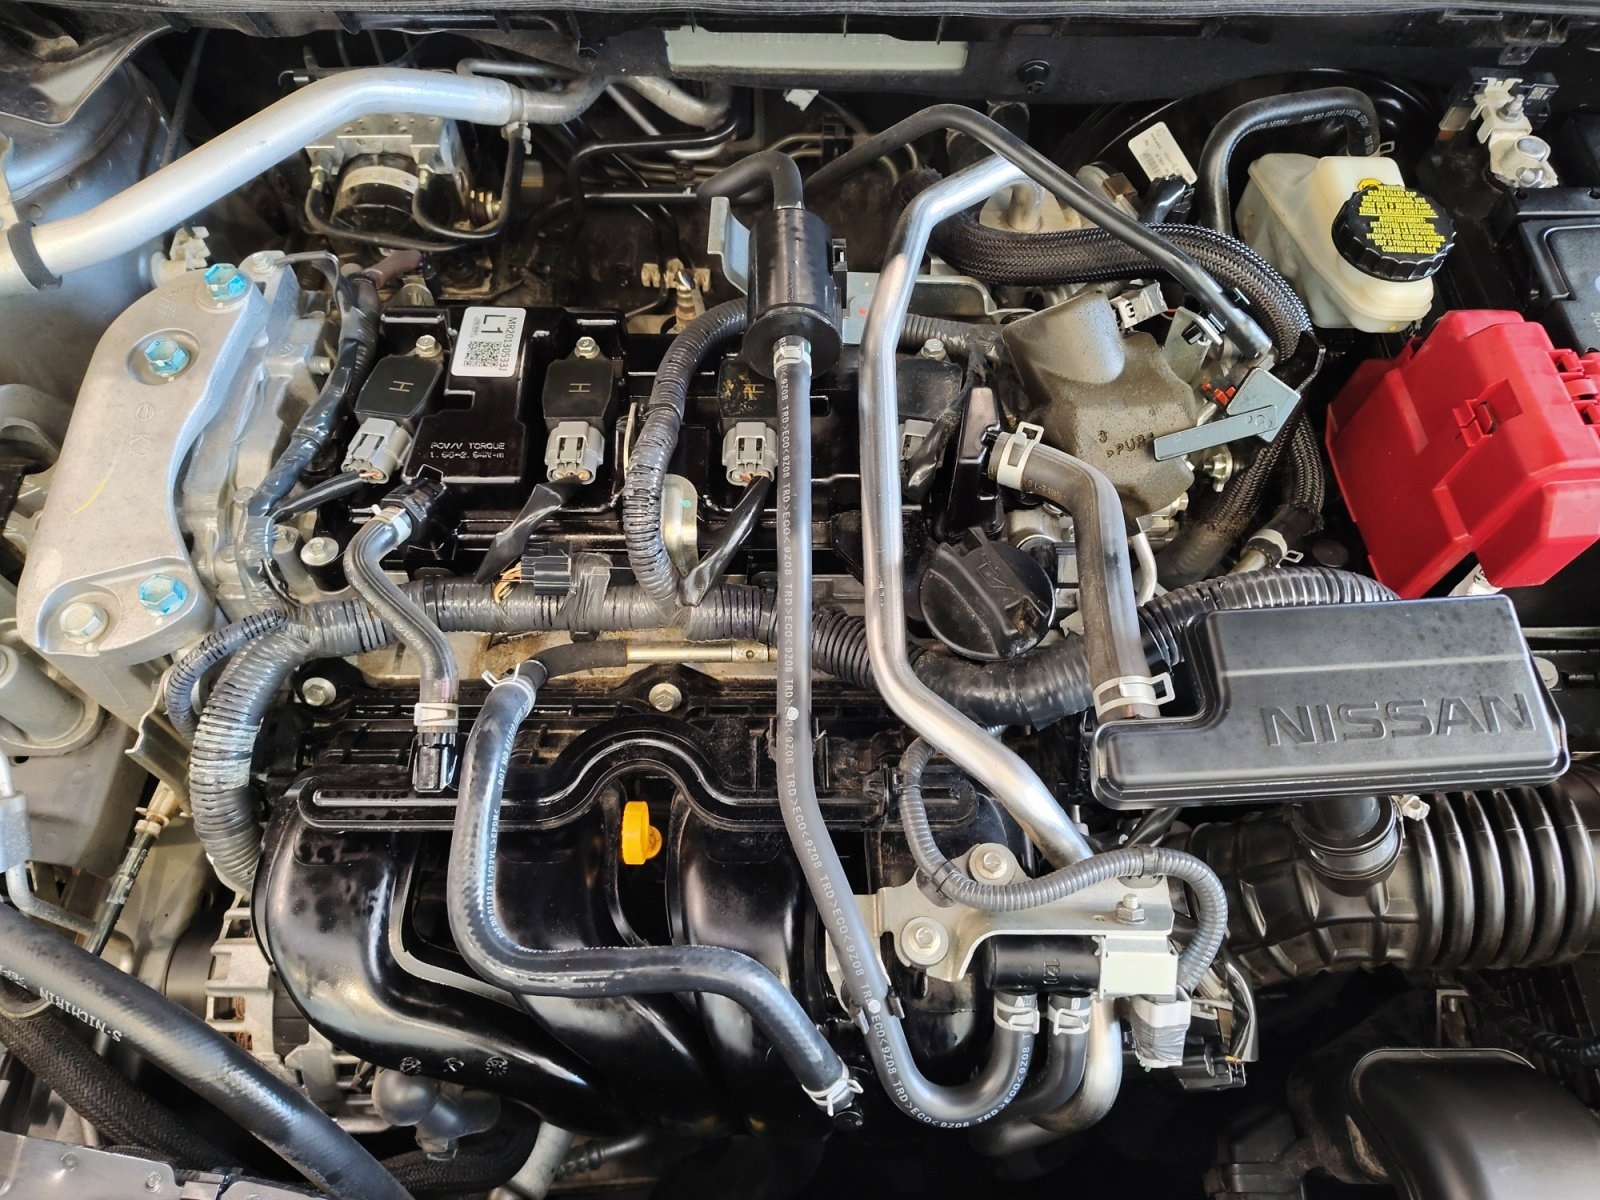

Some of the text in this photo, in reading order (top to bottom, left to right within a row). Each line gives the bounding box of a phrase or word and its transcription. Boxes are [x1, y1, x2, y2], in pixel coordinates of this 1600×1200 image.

[482, 314, 506, 334] L1
[469, 442, 506, 450] TORQUE
[1261, 693, 1537, 747] NISSAN
